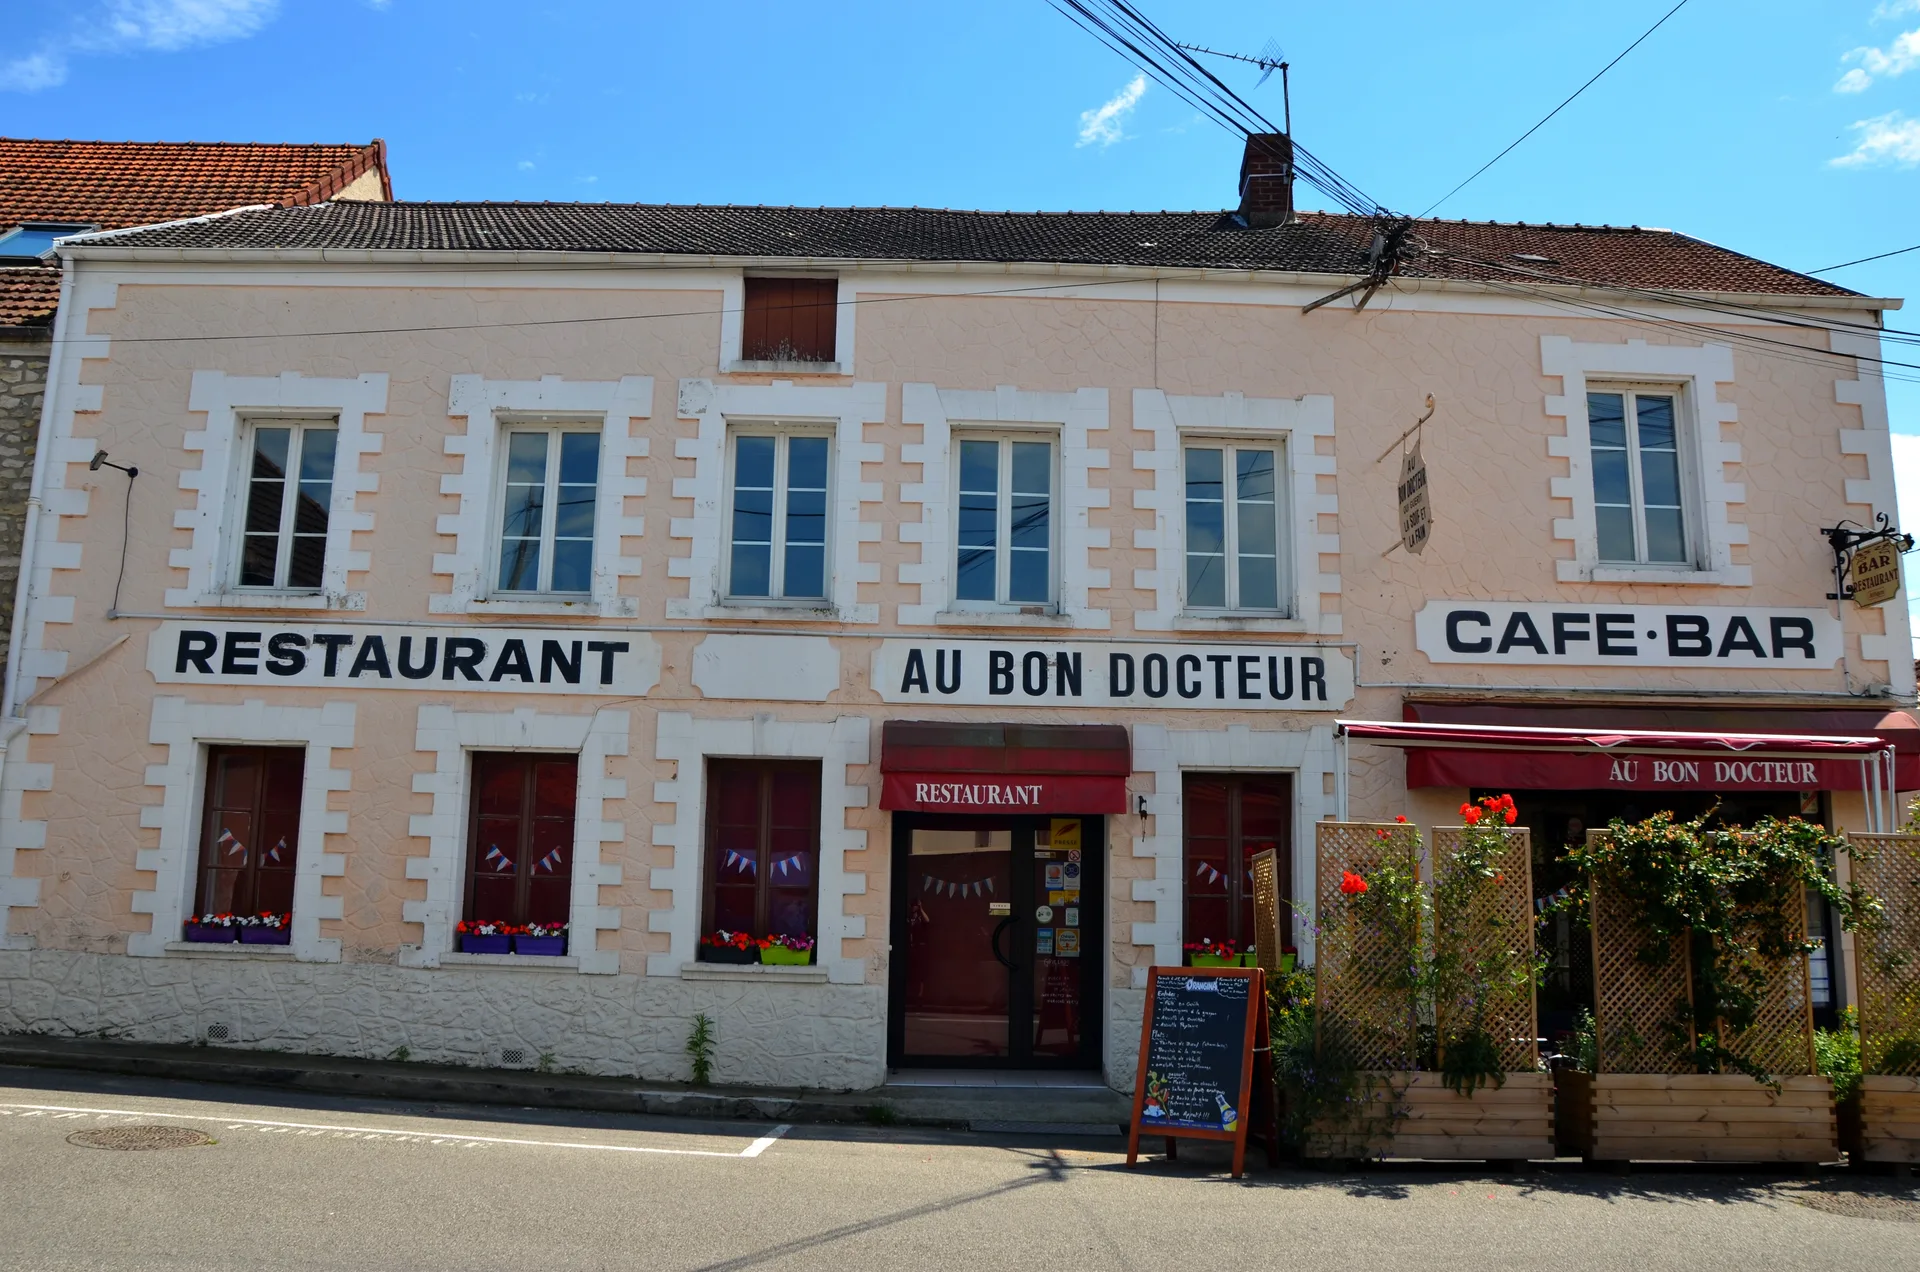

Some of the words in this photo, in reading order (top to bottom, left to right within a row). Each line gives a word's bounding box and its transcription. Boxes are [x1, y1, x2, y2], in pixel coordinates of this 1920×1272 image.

[1407, 456, 1416, 473] AU
[1406, 468, 1426, 497] DOCTEUR
[1404, 519, 1410, 532] LA
[1420, 507, 1426, 520] ET
[1409, 534, 1415, 547] LA
[1858, 555, 1890, 575] BAR
[1853, 569, 1898, 592] RESTAURANT
[174, 629, 629, 685] RESTAURANT
[900, 647, 962, 694] AU
[988, 650, 1082, 697] BON
[1109, 652, 1328, 702] DOCTEUR
[1609, 759, 1639, 781] AU
[1652, 760, 1699, 783] BON
[1714, 761, 1818, 784] DOCTEUR
[915, 783, 1043, 805] RESTAURANT
